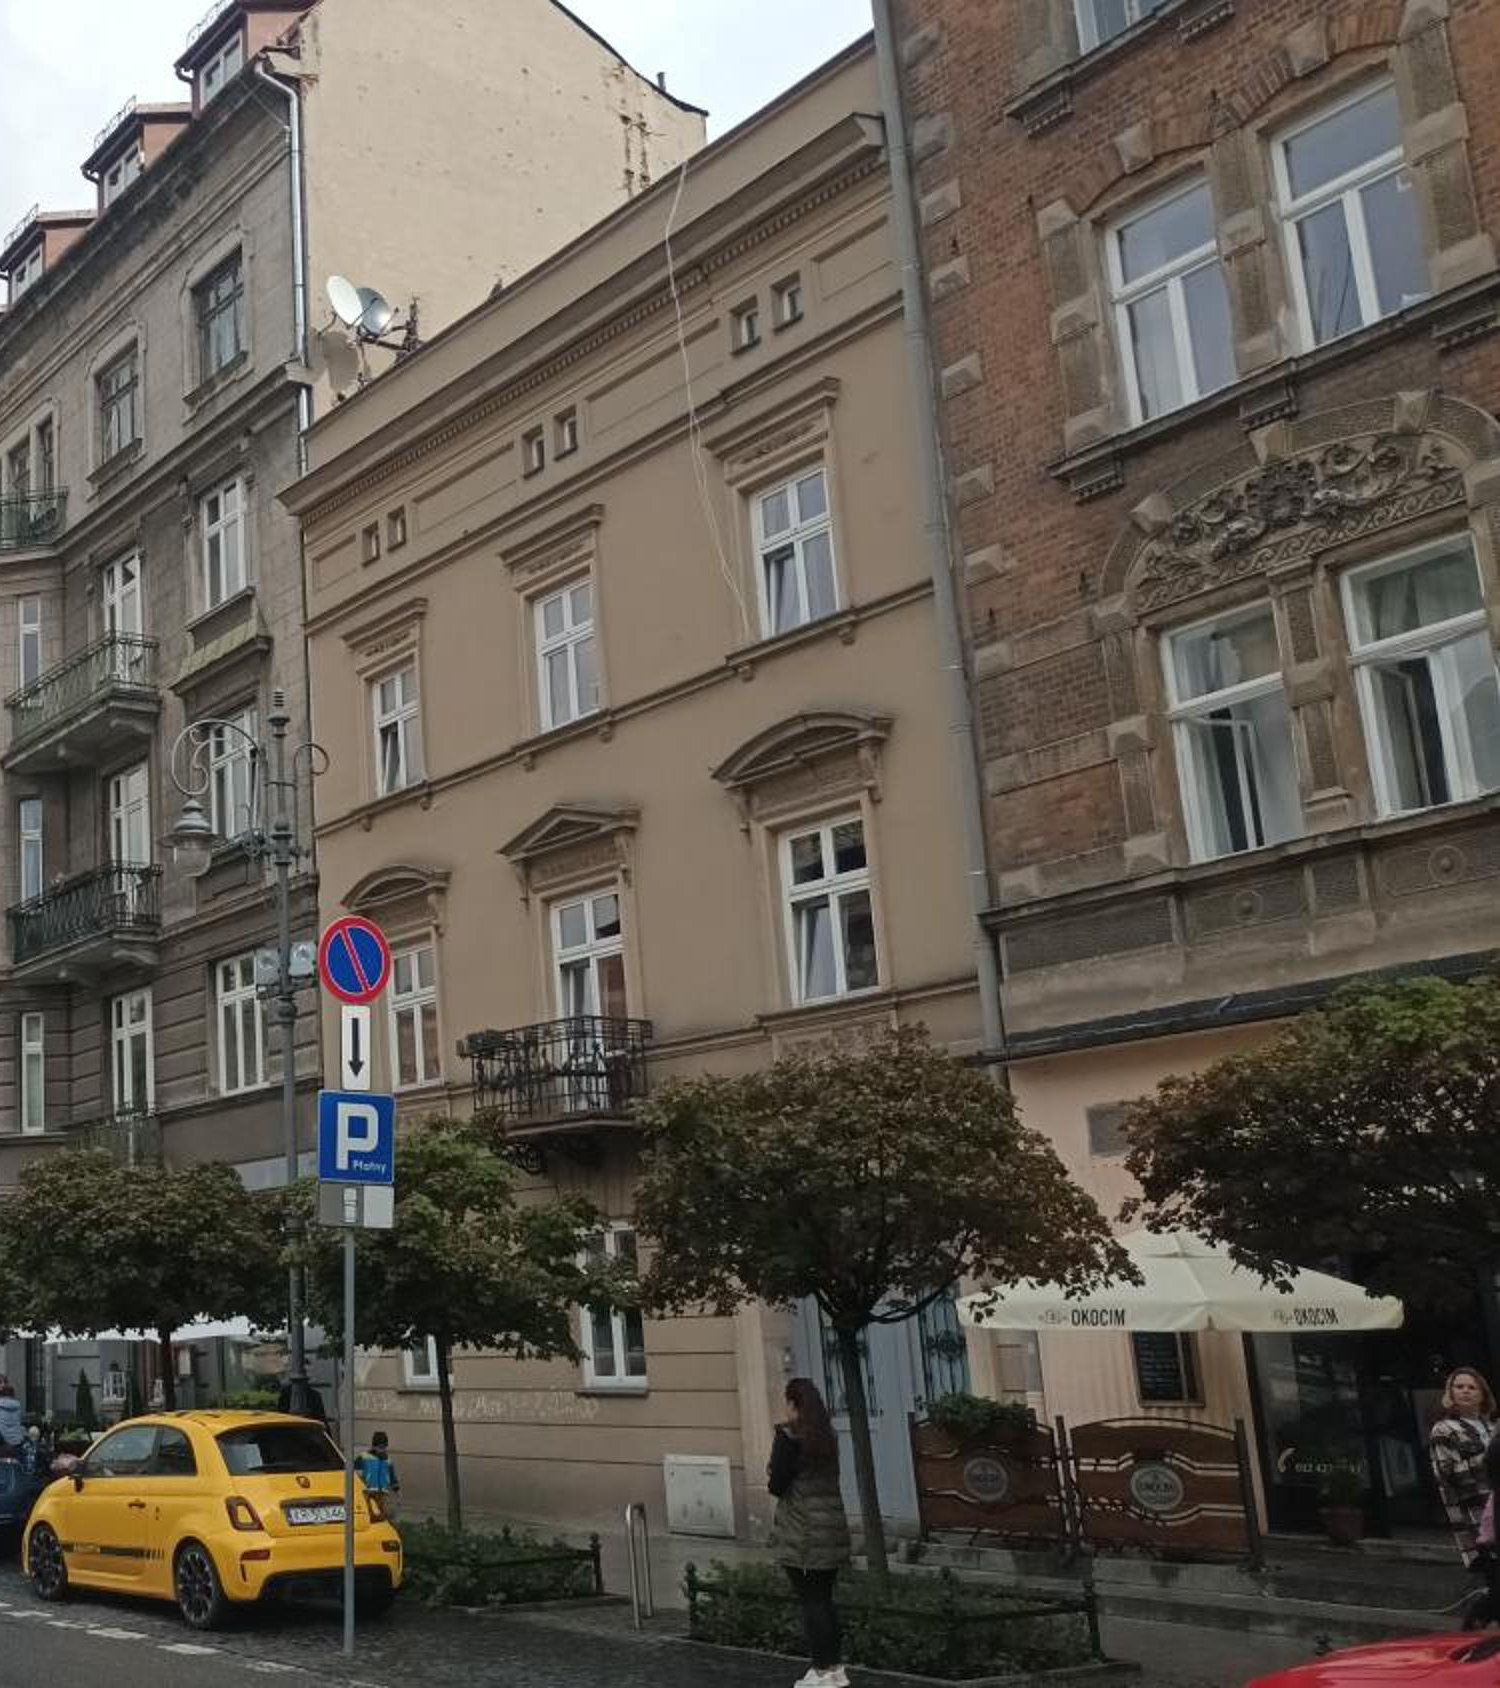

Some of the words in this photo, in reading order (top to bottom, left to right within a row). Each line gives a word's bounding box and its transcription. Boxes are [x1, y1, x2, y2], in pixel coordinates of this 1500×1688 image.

[336, 1102, 379, 1170] P
[1071, 1308, 1125, 1326] OKOCIM
[1293, 1307, 1340, 1326] OKOCIM
